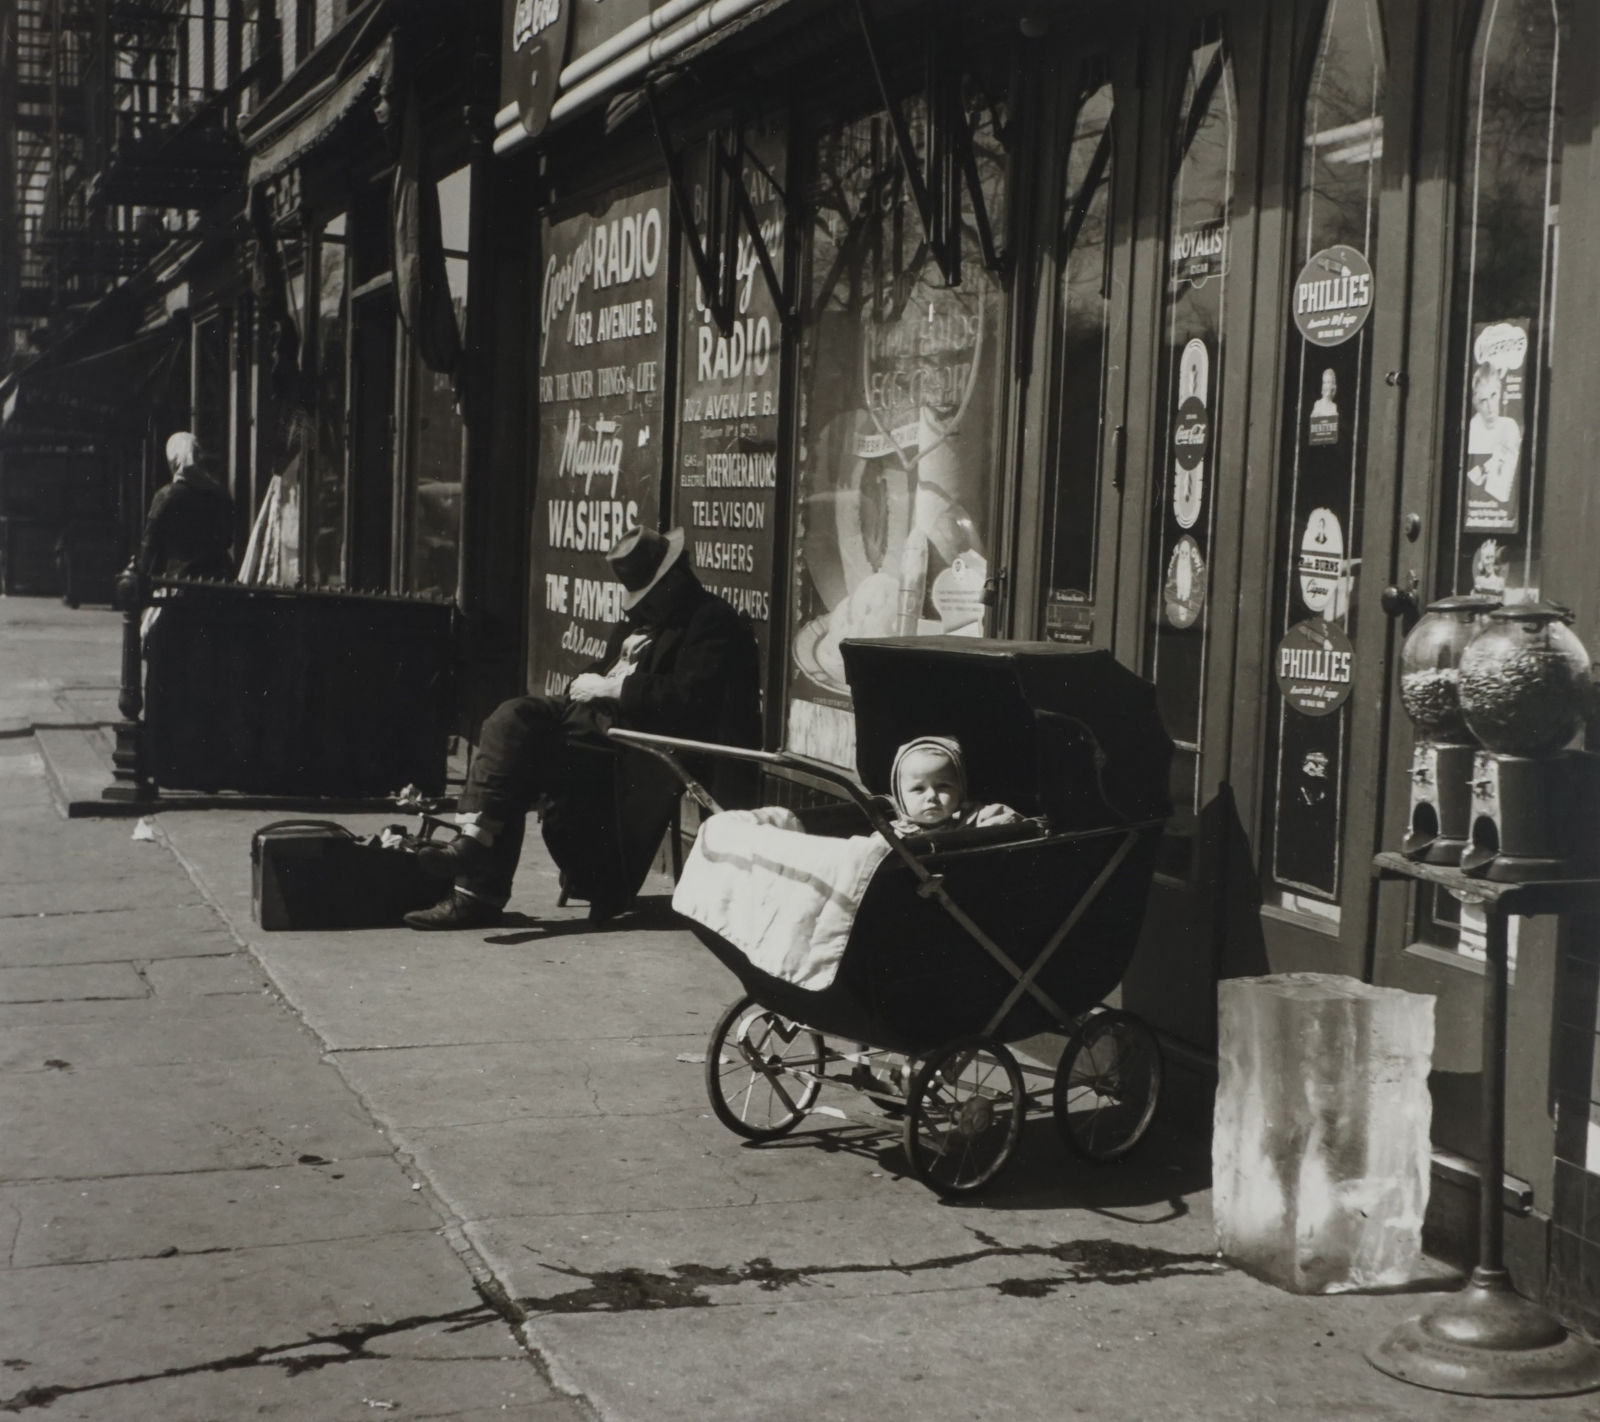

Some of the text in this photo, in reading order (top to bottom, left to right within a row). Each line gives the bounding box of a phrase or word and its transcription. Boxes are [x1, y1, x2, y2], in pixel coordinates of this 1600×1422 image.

[593, 207, 661, 290] RADIO
[1298, 273, 1370, 314] PHILLIES
[574, 298, 658, 347] 182 AVENUE B.
[698, 315, 771, 382] RADIO
[555, 372, 570, 401] THE
[598, 364, 627, 397] THINGS
[636, 361, 658, 393] LIFE
[559, 408, 623, 499] Maytag
[706, 452, 777, 488] REFRIGERATORS
[549, 499, 639, 552] WASHERS
[692, 501, 766, 529] TELEVISION
[695, 541, 755, 573] WASHERS
[1280, 648, 1351, 683] PHILLIES
